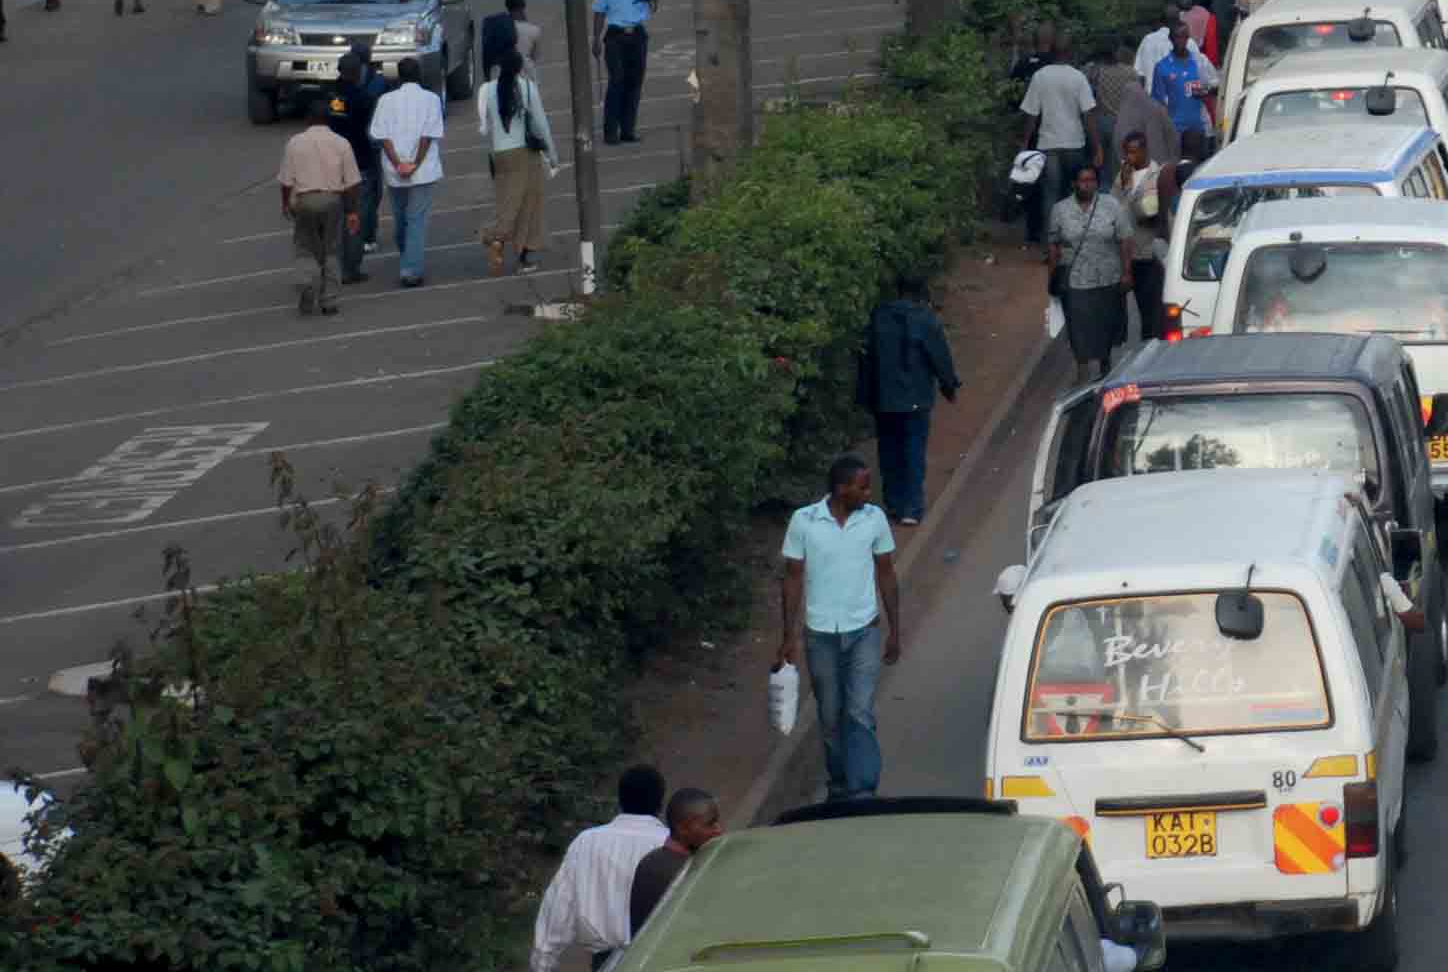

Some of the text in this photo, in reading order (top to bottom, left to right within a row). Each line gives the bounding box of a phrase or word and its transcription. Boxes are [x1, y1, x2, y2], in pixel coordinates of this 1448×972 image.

[1272, 770, 1297, 789] 80
[1152, 812, 1197, 833] KAT
[1152, 835, 1214, 856] 032B
